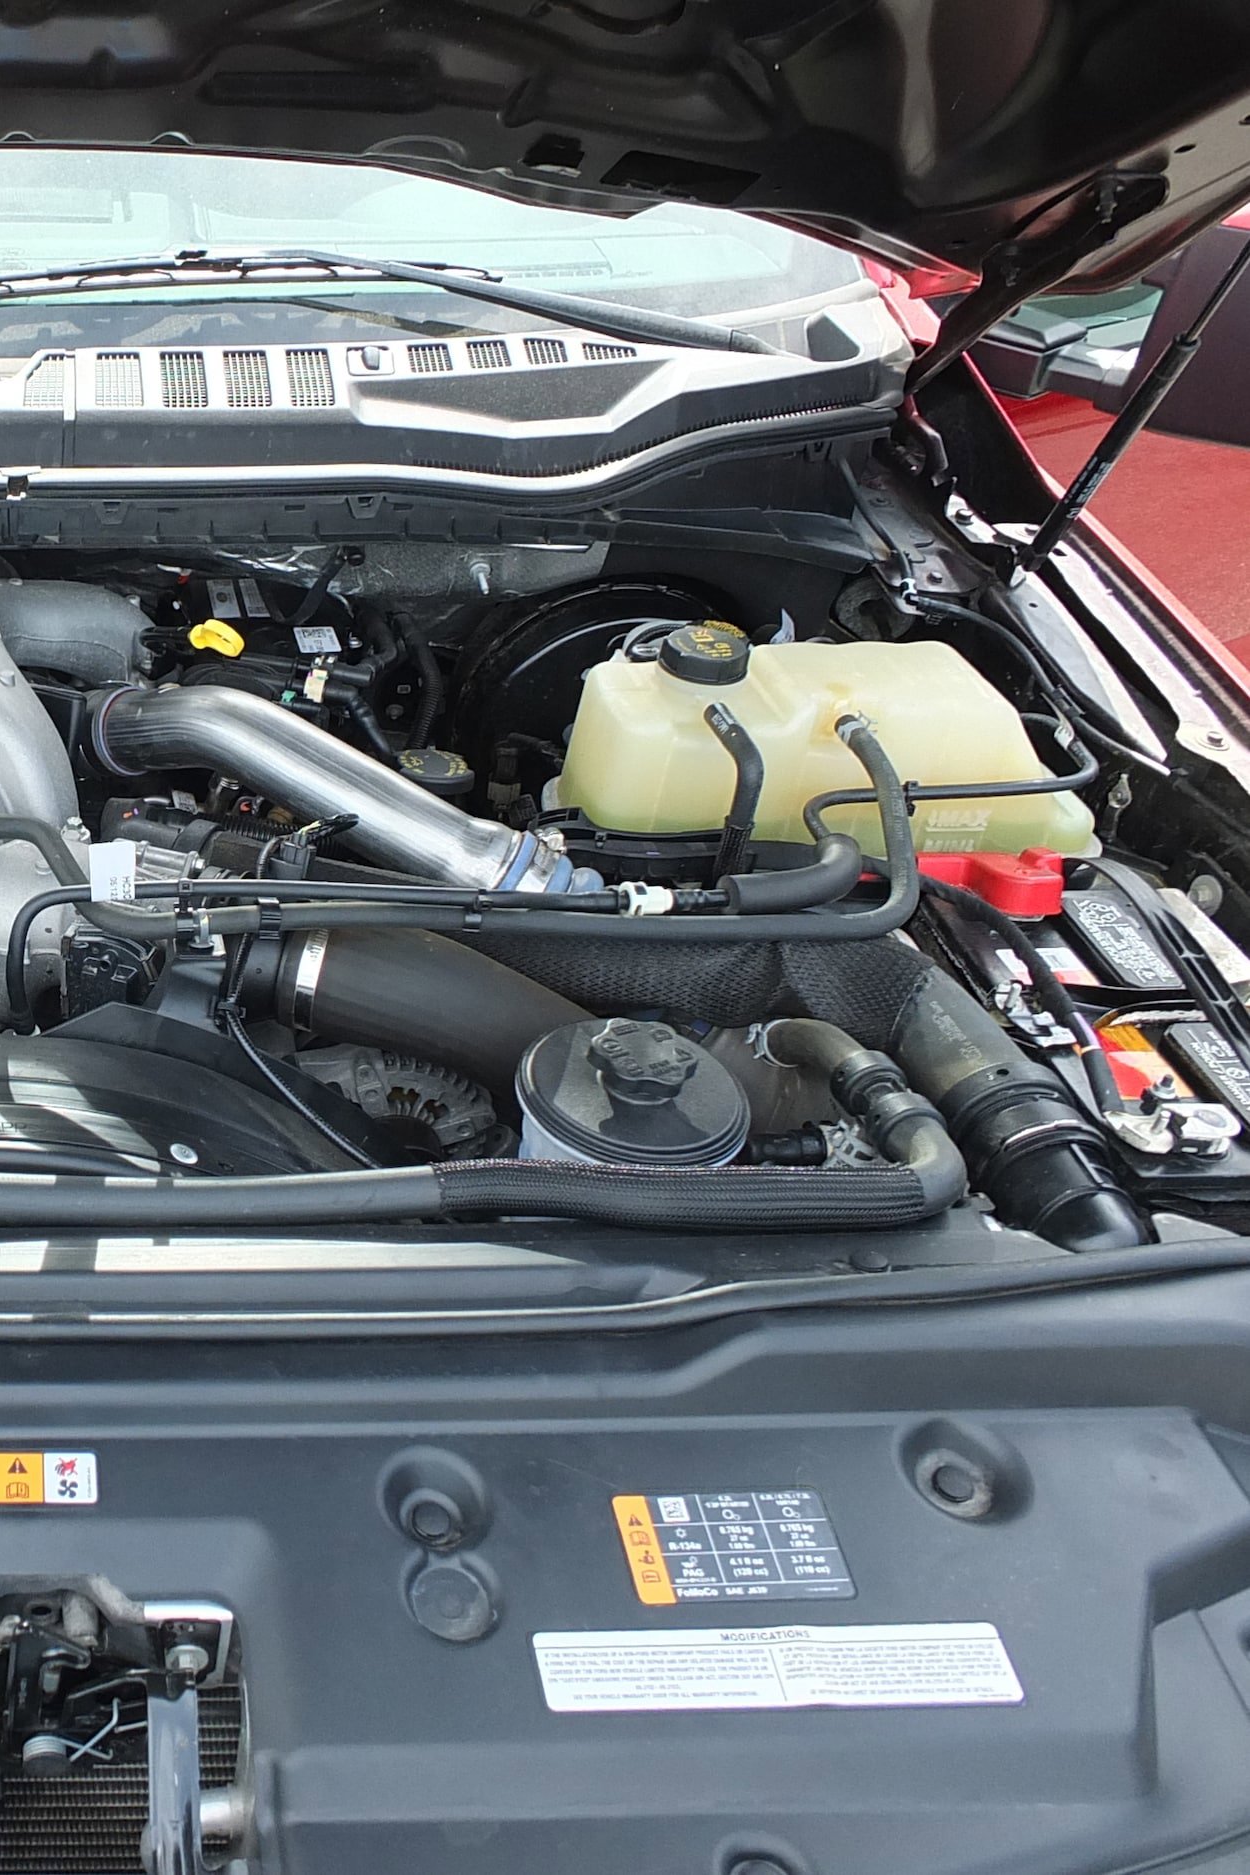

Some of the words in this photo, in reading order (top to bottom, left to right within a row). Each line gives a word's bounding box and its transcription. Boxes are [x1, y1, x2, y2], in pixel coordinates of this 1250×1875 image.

[668, 1541, 702, 1551] R-134a
[682, 1568, 705, 1577] PAG
[676, 1586, 719, 1597] FoMoCo
[720, 1629, 811, 1641] MODIFICATIONS
